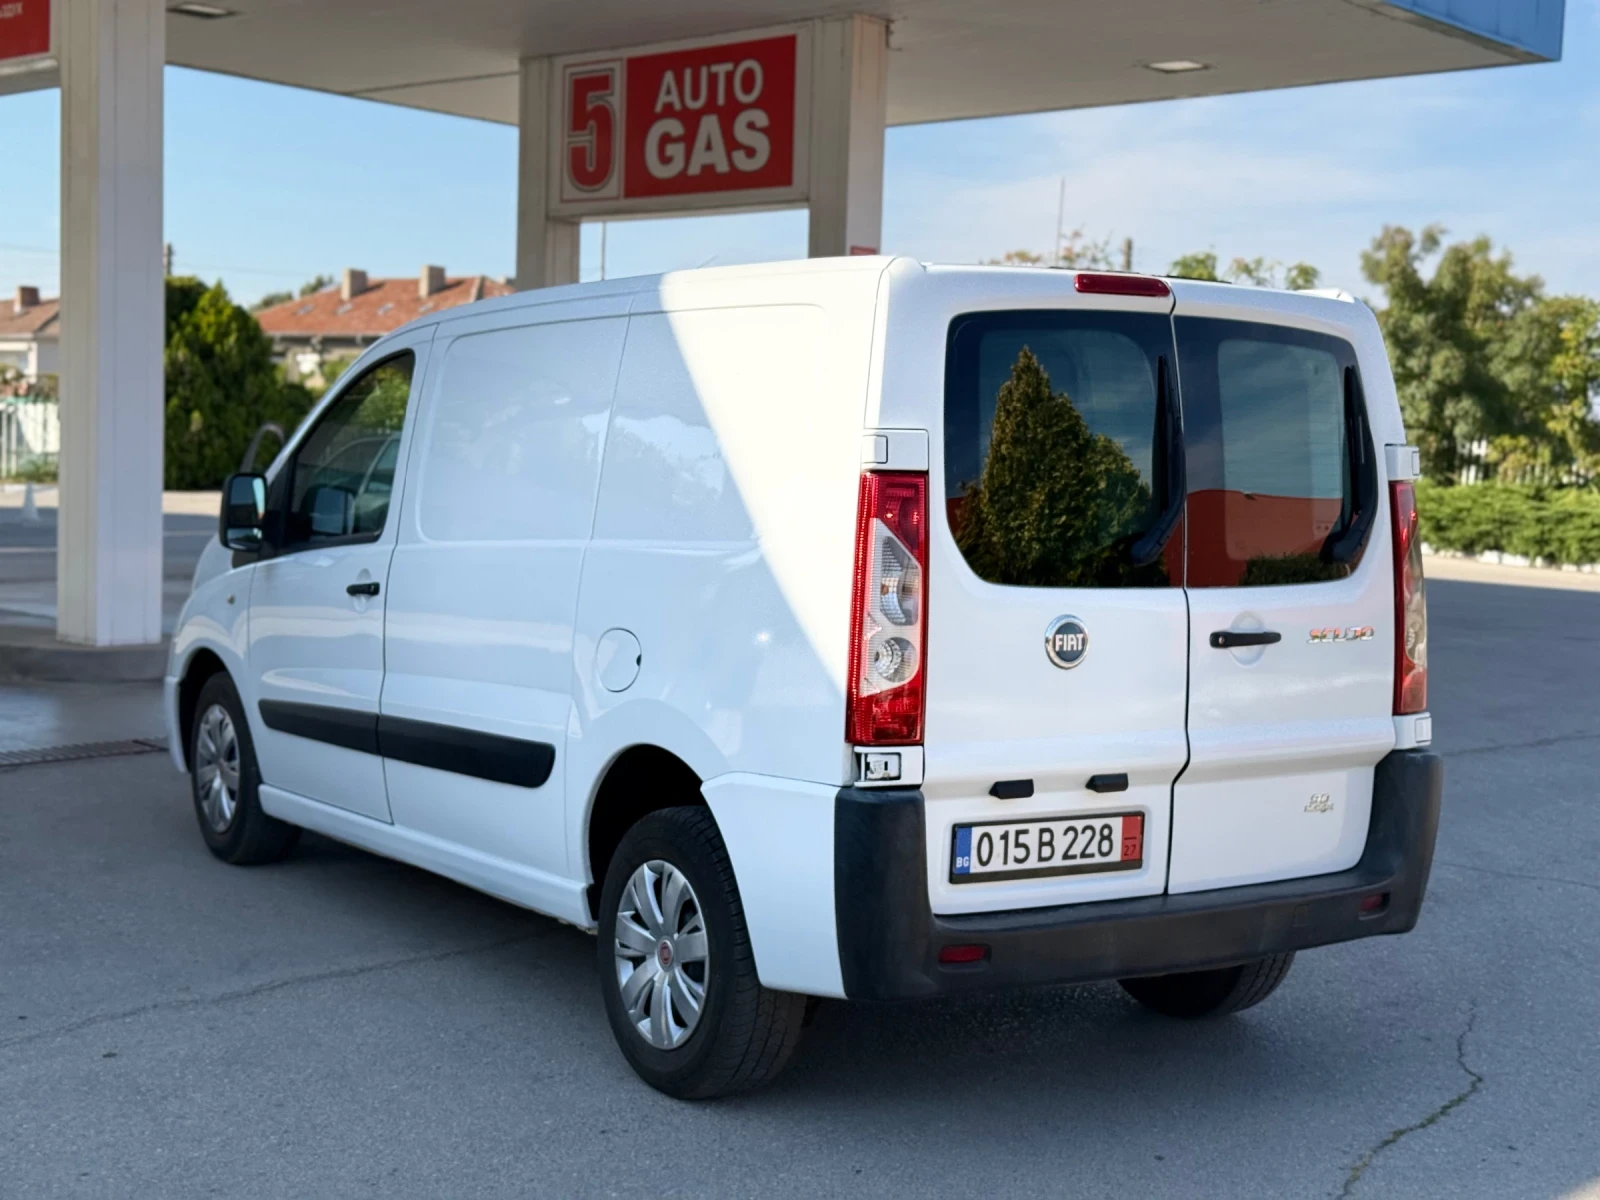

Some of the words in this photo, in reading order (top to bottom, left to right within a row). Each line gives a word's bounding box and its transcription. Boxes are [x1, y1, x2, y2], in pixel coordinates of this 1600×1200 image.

[654, 58, 764, 114] AUTO
[566, 67, 617, 194] 5
[643, 107, 771, 180] GAS
[1055, 633, 1084, 652] FIAT
[955, 855, 970, 868] BG
[1123, 843, 1137, 857] 27
